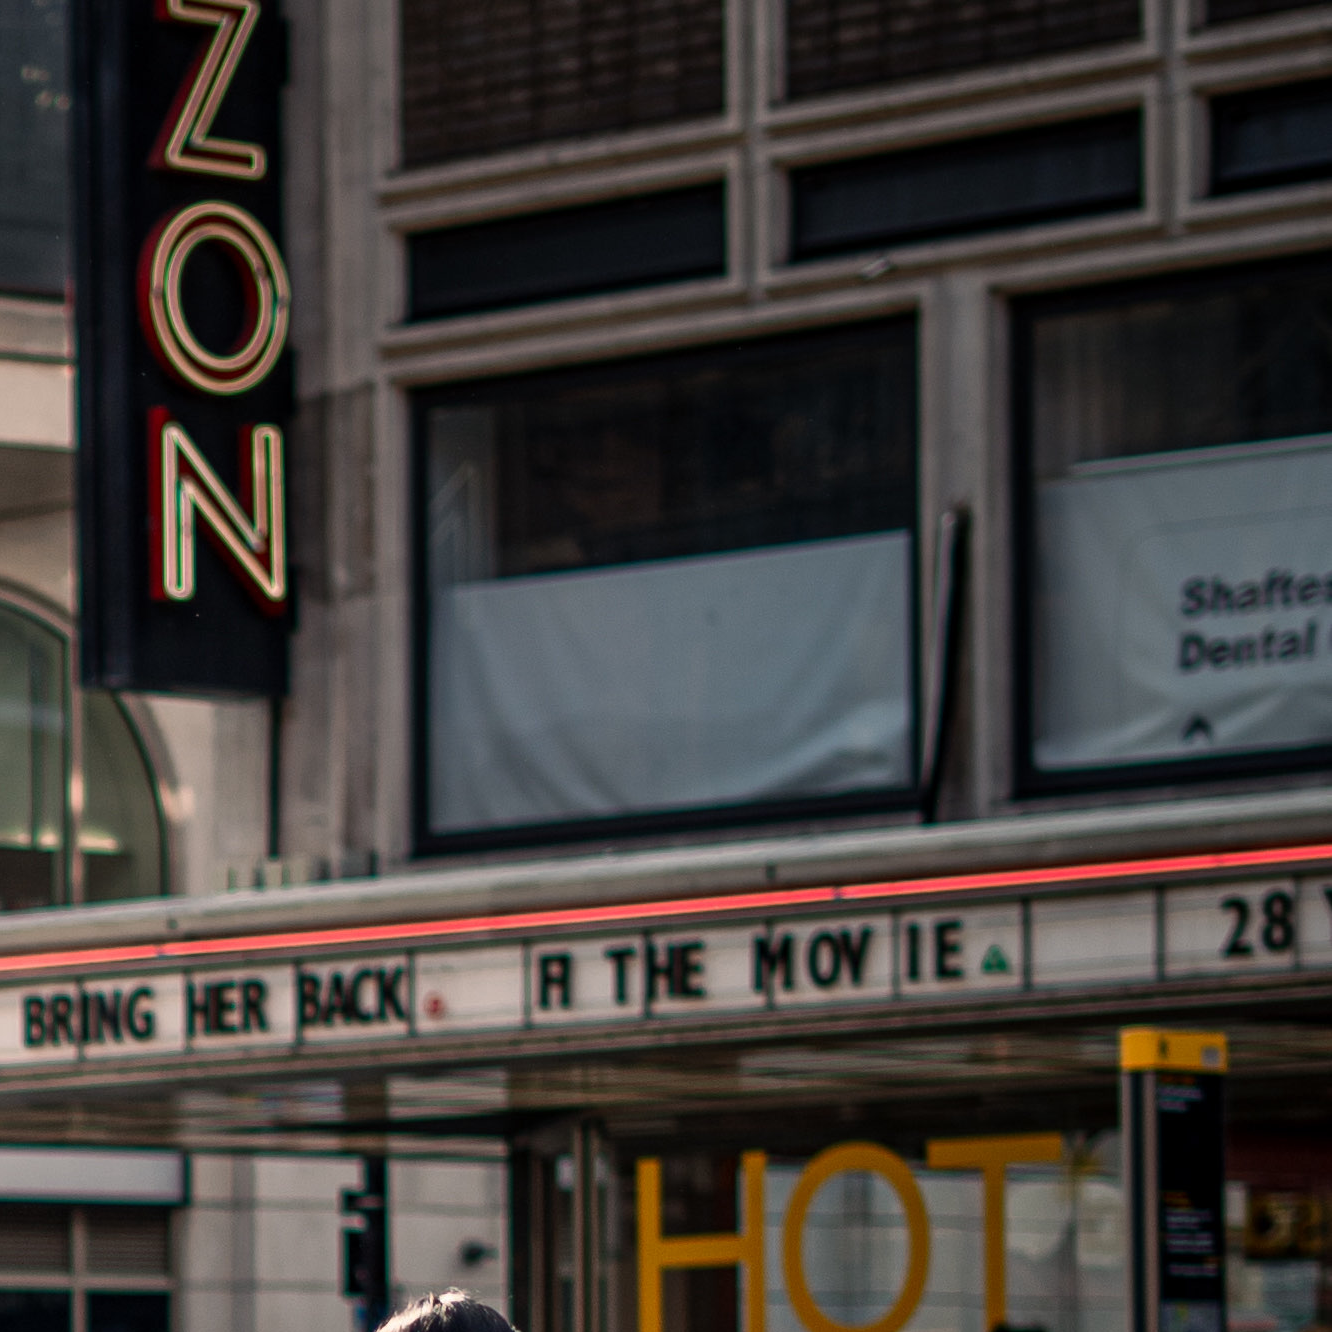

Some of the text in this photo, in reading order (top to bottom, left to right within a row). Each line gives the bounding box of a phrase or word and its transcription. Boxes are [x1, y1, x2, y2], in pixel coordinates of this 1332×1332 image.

[1178, 619, 1318, 672] Dental
[1221, 890, 1295, 958] 28
[605, 940, 706, 1005] THE
[23, 966, 408, 1048] BRING HER BACK
